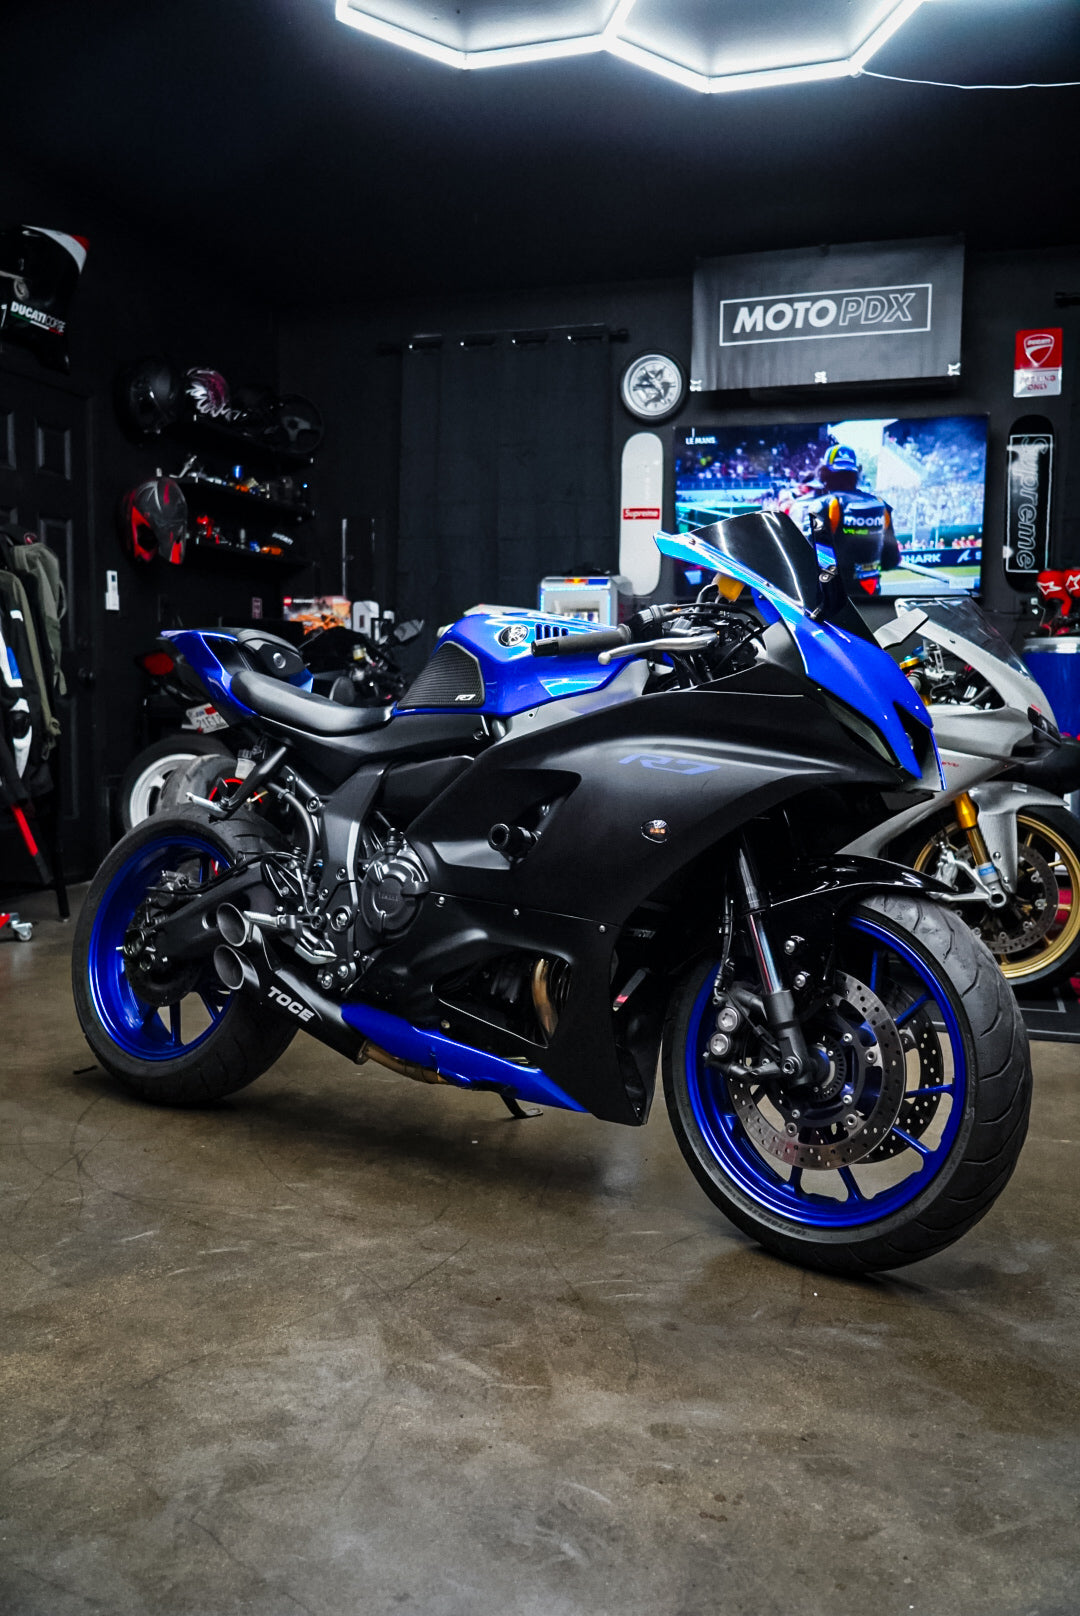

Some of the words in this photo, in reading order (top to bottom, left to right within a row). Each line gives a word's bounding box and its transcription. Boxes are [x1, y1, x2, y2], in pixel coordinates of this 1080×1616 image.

[733, 299, 837, 333] MOTO
[839, 293, 916, 326] PDX
[268, 986, 315, 1022] TOCE
